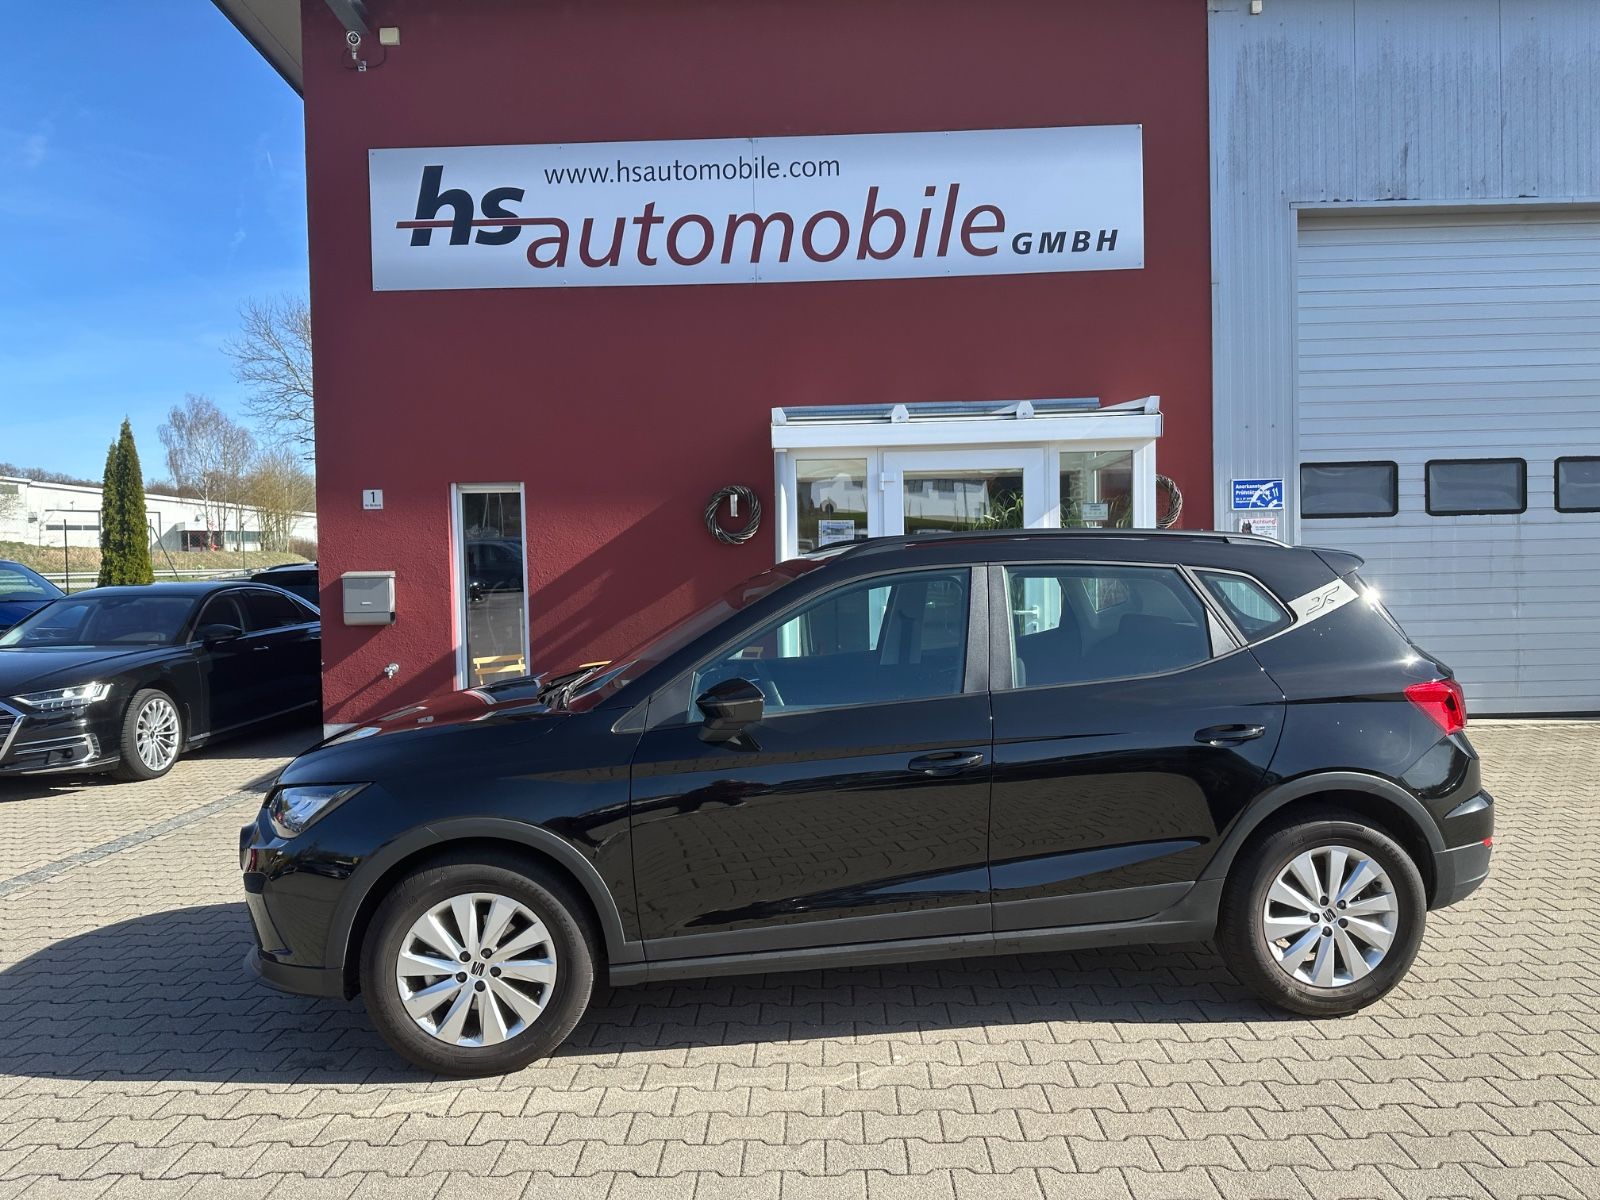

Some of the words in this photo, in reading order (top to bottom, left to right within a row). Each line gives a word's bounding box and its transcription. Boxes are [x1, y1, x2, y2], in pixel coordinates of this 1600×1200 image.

[544, 155, 841, 185] www.hsautomobile.com
[410, 164, 525, 247] hs
[526, 182, 1007, 269] automobile
[1012, 229, 1119, 255] GMBH
[371, 491, 375, 503] 1
